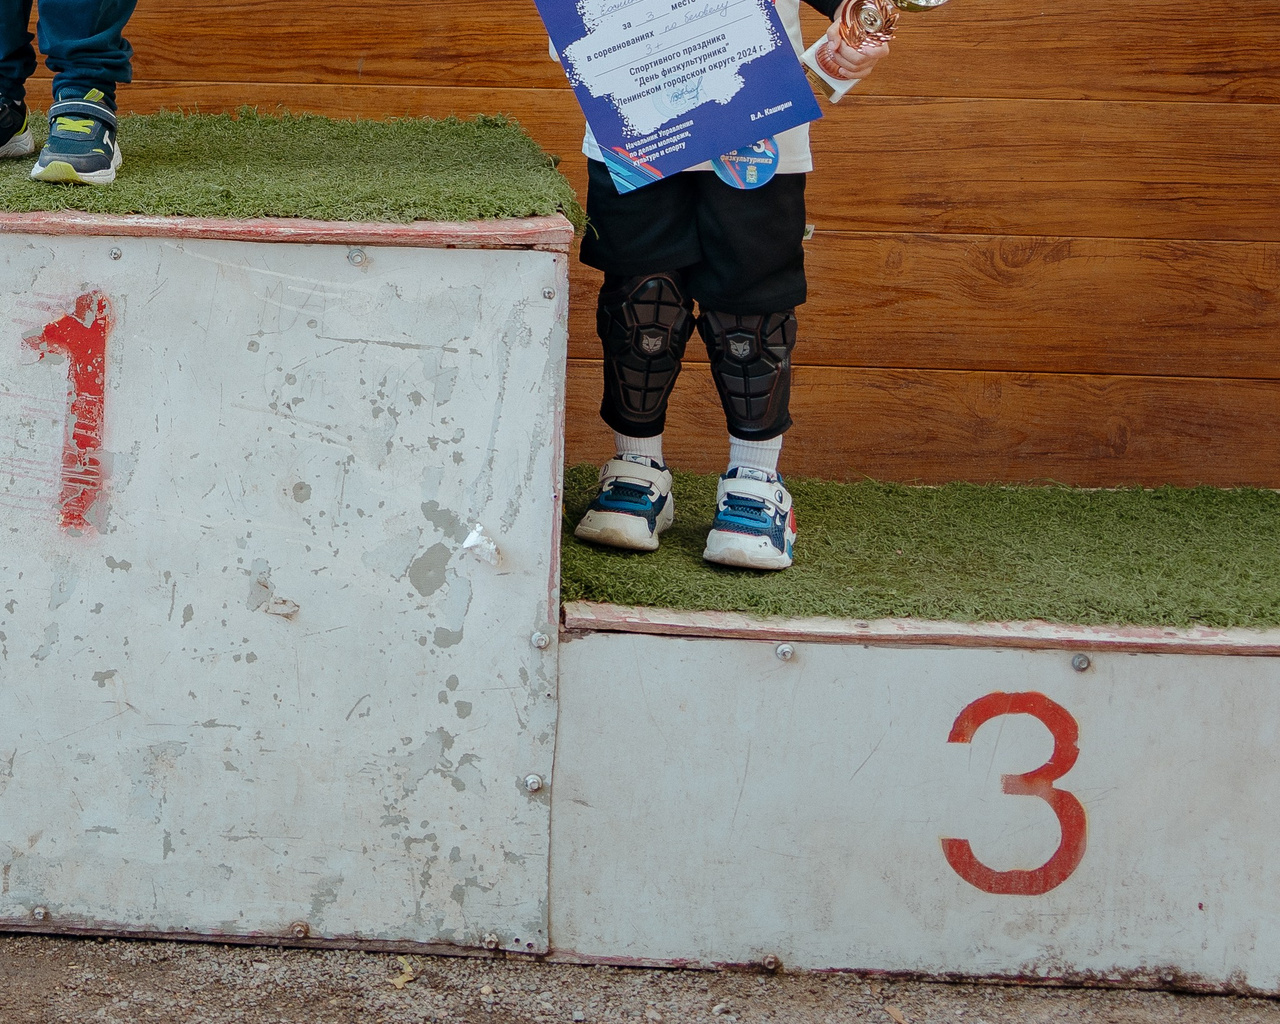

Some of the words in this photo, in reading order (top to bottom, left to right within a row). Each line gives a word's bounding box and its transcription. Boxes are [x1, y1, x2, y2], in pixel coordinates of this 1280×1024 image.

[593, 31, 655, 60] соревнованиях
[621, 20, 632, 30] за
[629, 51, 681, 76] Спортивного
[683, 33, 726, 56] праздника
[616, 85, 662, 107] Ленинском
[663, 67, 707, 90] городском
[708, 57, 736, 72] округе
[737, 46, 758, 61] 2024
[665, 141, 686, 155] спорту
[22, 290, 110, 531] 1
[941, 691, 1088, 896] 3
